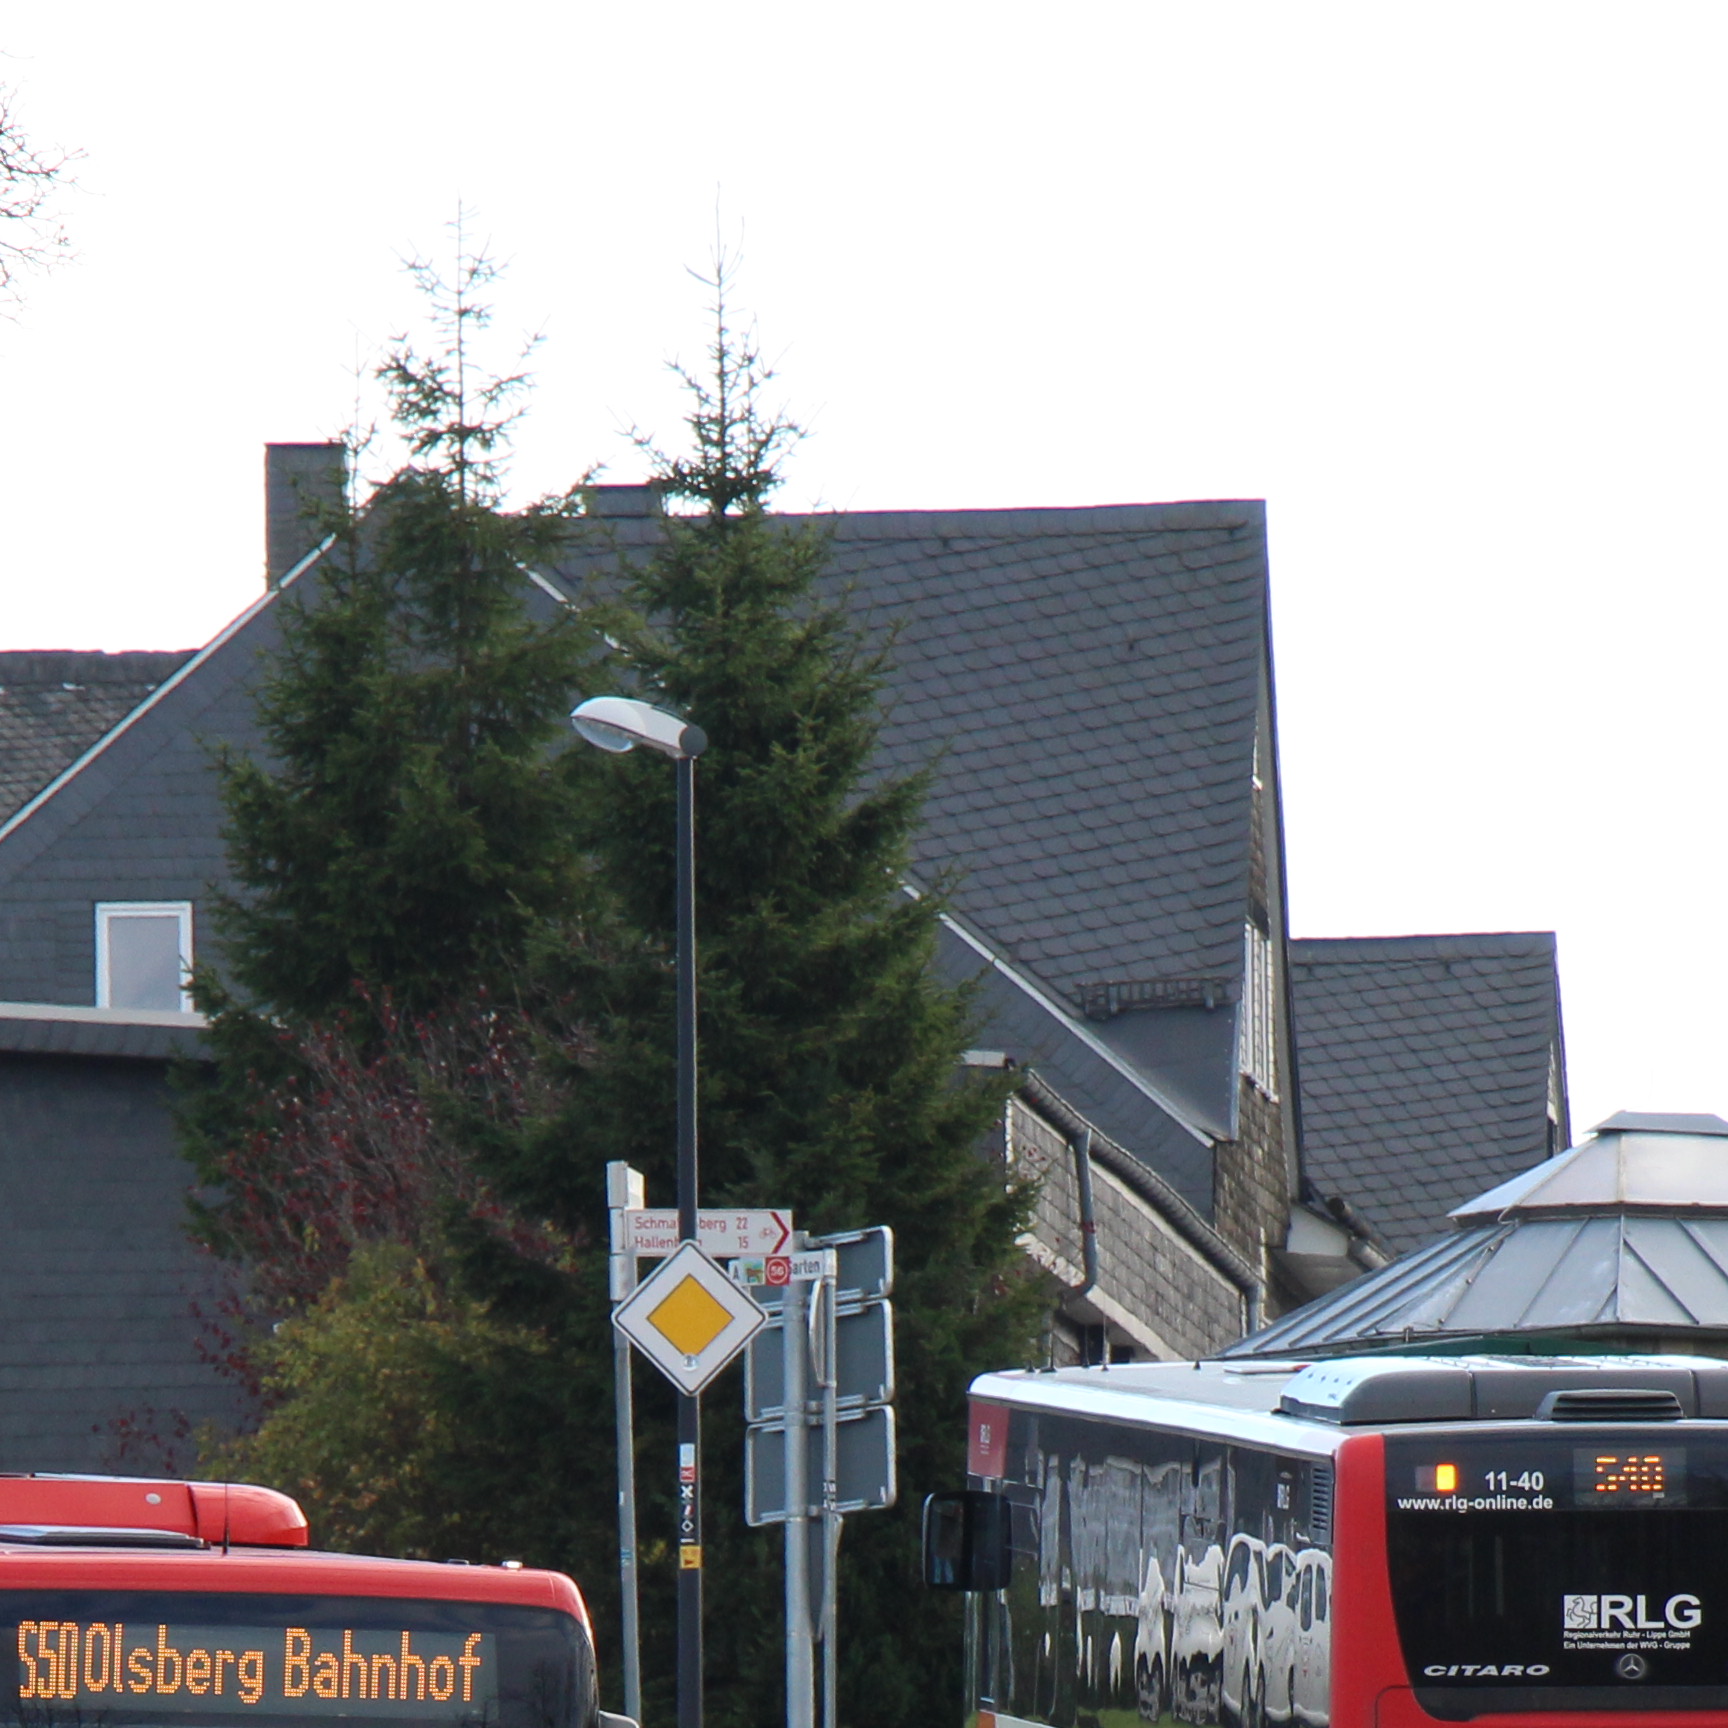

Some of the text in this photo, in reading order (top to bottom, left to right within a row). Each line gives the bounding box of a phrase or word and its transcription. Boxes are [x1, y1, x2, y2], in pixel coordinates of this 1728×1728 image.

[635, 1216, 748, 1232] Schmaberg 22
[739, 1236, 749, 1249] 15
[789, 1259, 821, 1275] arten
[1484, 1471, 1544, 1491] 11-40
[1595, 1455, 1664, 1492] 540
[1398, 1494, 1553, 1513] www.rlg-online.de
[1600, 1594, 1702, 1629] RLG
[84, 1622, 264, 1704] Olsberg
[283, 1628, 482, 1702] Bahnhof
[1423, 1664, 1550, 1677] CITARO
